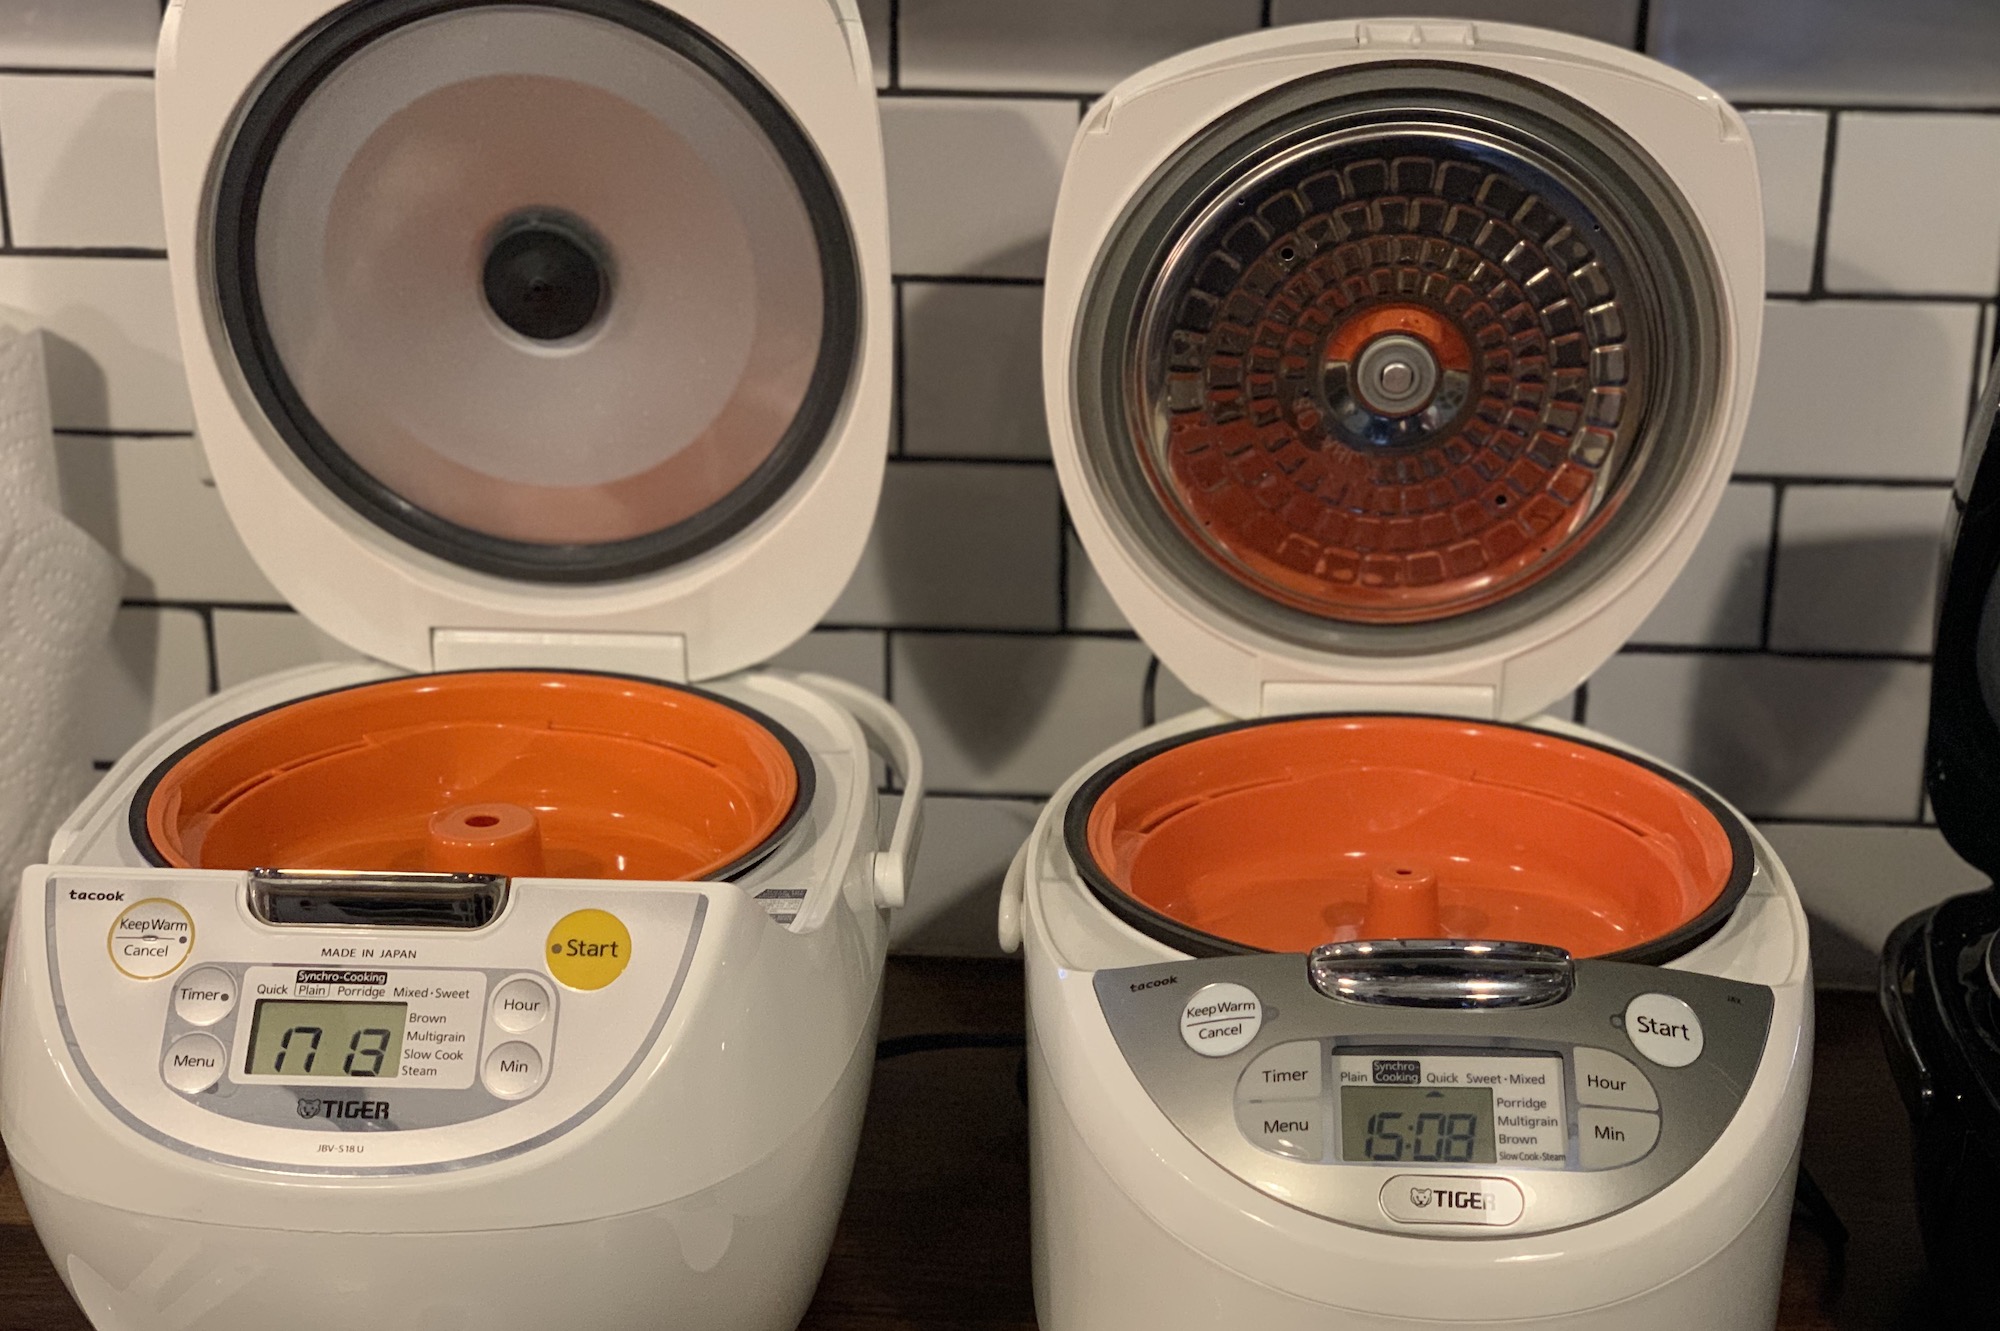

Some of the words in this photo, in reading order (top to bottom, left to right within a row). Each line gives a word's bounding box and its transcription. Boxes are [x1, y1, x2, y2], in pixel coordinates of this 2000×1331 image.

[69, 889, 125, 902] tacook
[123, 944, 169, 958] Cancel
[321, 948, 356, 958] MADE
[361, 949, 374, 958] IN
[380, 949, 417, 959] JAPAN
[566, 938, 619, 958] Start
[1130, 975, 1178, 993] tacook
[180, 988, 220, 1001] Timer
[257, 984, 288, 995] Quick
[298, 985, 326, 996] Plain
[337, 985, 386, 999] Porridge
[503, 998, 541, 1012] Hour
[409, 1013, 447, 1023] Brown
[1199, 1023, 1243, 1040] Cancel
[1637, 1016, 1690, 1041] Start
[406, 1031, 466, 1044] Multigrain
[173, 1055, 215, 1069] Menu
[403, 1050, 431, 1060] Slow
[435, 1050, 464, 1060] Cook
[401, 1066, 437, 1076] Steam
[500, 1060, 528, 1073] Min
[1262, 1070, 1309, 1083] Timer
[1340, 1072, 1368, 1083] Plain
[1375, 1071, 1419, 1084] Cooking
[1426, 1072, 1459, 1084] Quick
[1587, 1074, 1626, 1091] Hour
[323, 1101, 389, 1119] TIGER
[1497, 1098, 1547, 1109] Porridge
[1264, 1119, 1309, 1134] Menu
[1498, 1116, 1558, 1128] Multigrain
[1365, 1112, 1477, 1162] 15:08
[1499, 1135, 1538, 1145] Brown
[1594, 1125, 1625, 1141] Min
[1433, 1190, 1496, 1211] TIGER
